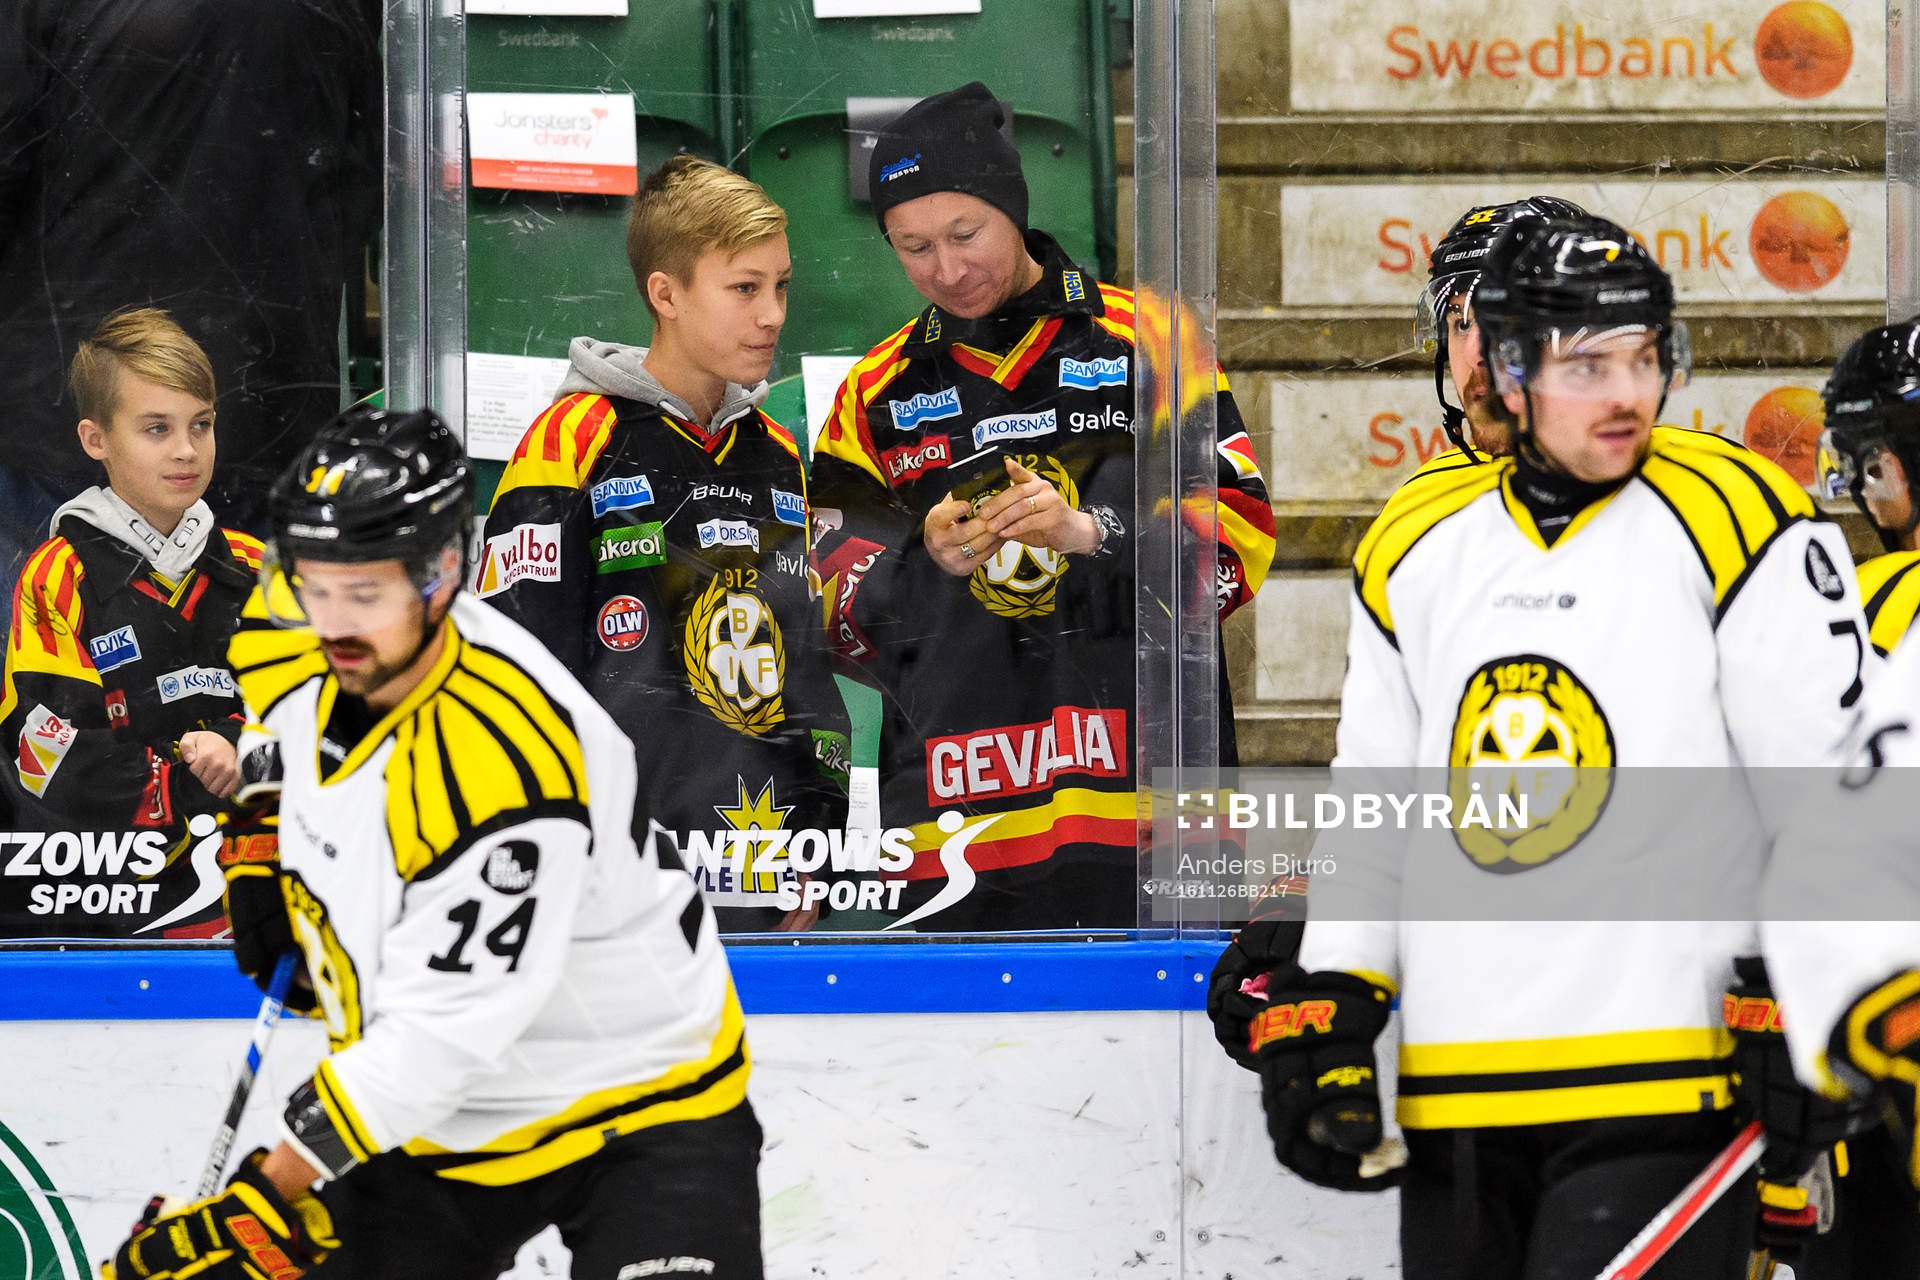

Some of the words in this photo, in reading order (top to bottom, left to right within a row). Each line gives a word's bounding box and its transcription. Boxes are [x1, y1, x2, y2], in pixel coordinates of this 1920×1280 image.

[1386, 23, 1738, 82] Swedbank
[1063, 359, 1125, 377] SANDVIK
[894, 390, 957, 416] SANDVIK
[988, 414, 1056, 436] KORSNÄS
[593, 479, 646, 502] SANDVIK
[774, 493, 806, 514] SAND
[603, 610, 643, 636] OLW
[1492, 662, 1549, 691] 1912
[931, 711, 1118, 799] GEVALIA
[27, 883, 160, 915] SPORT
[776, 880, 908, 912] SPORT
[427, 898, 538, 974] 14
